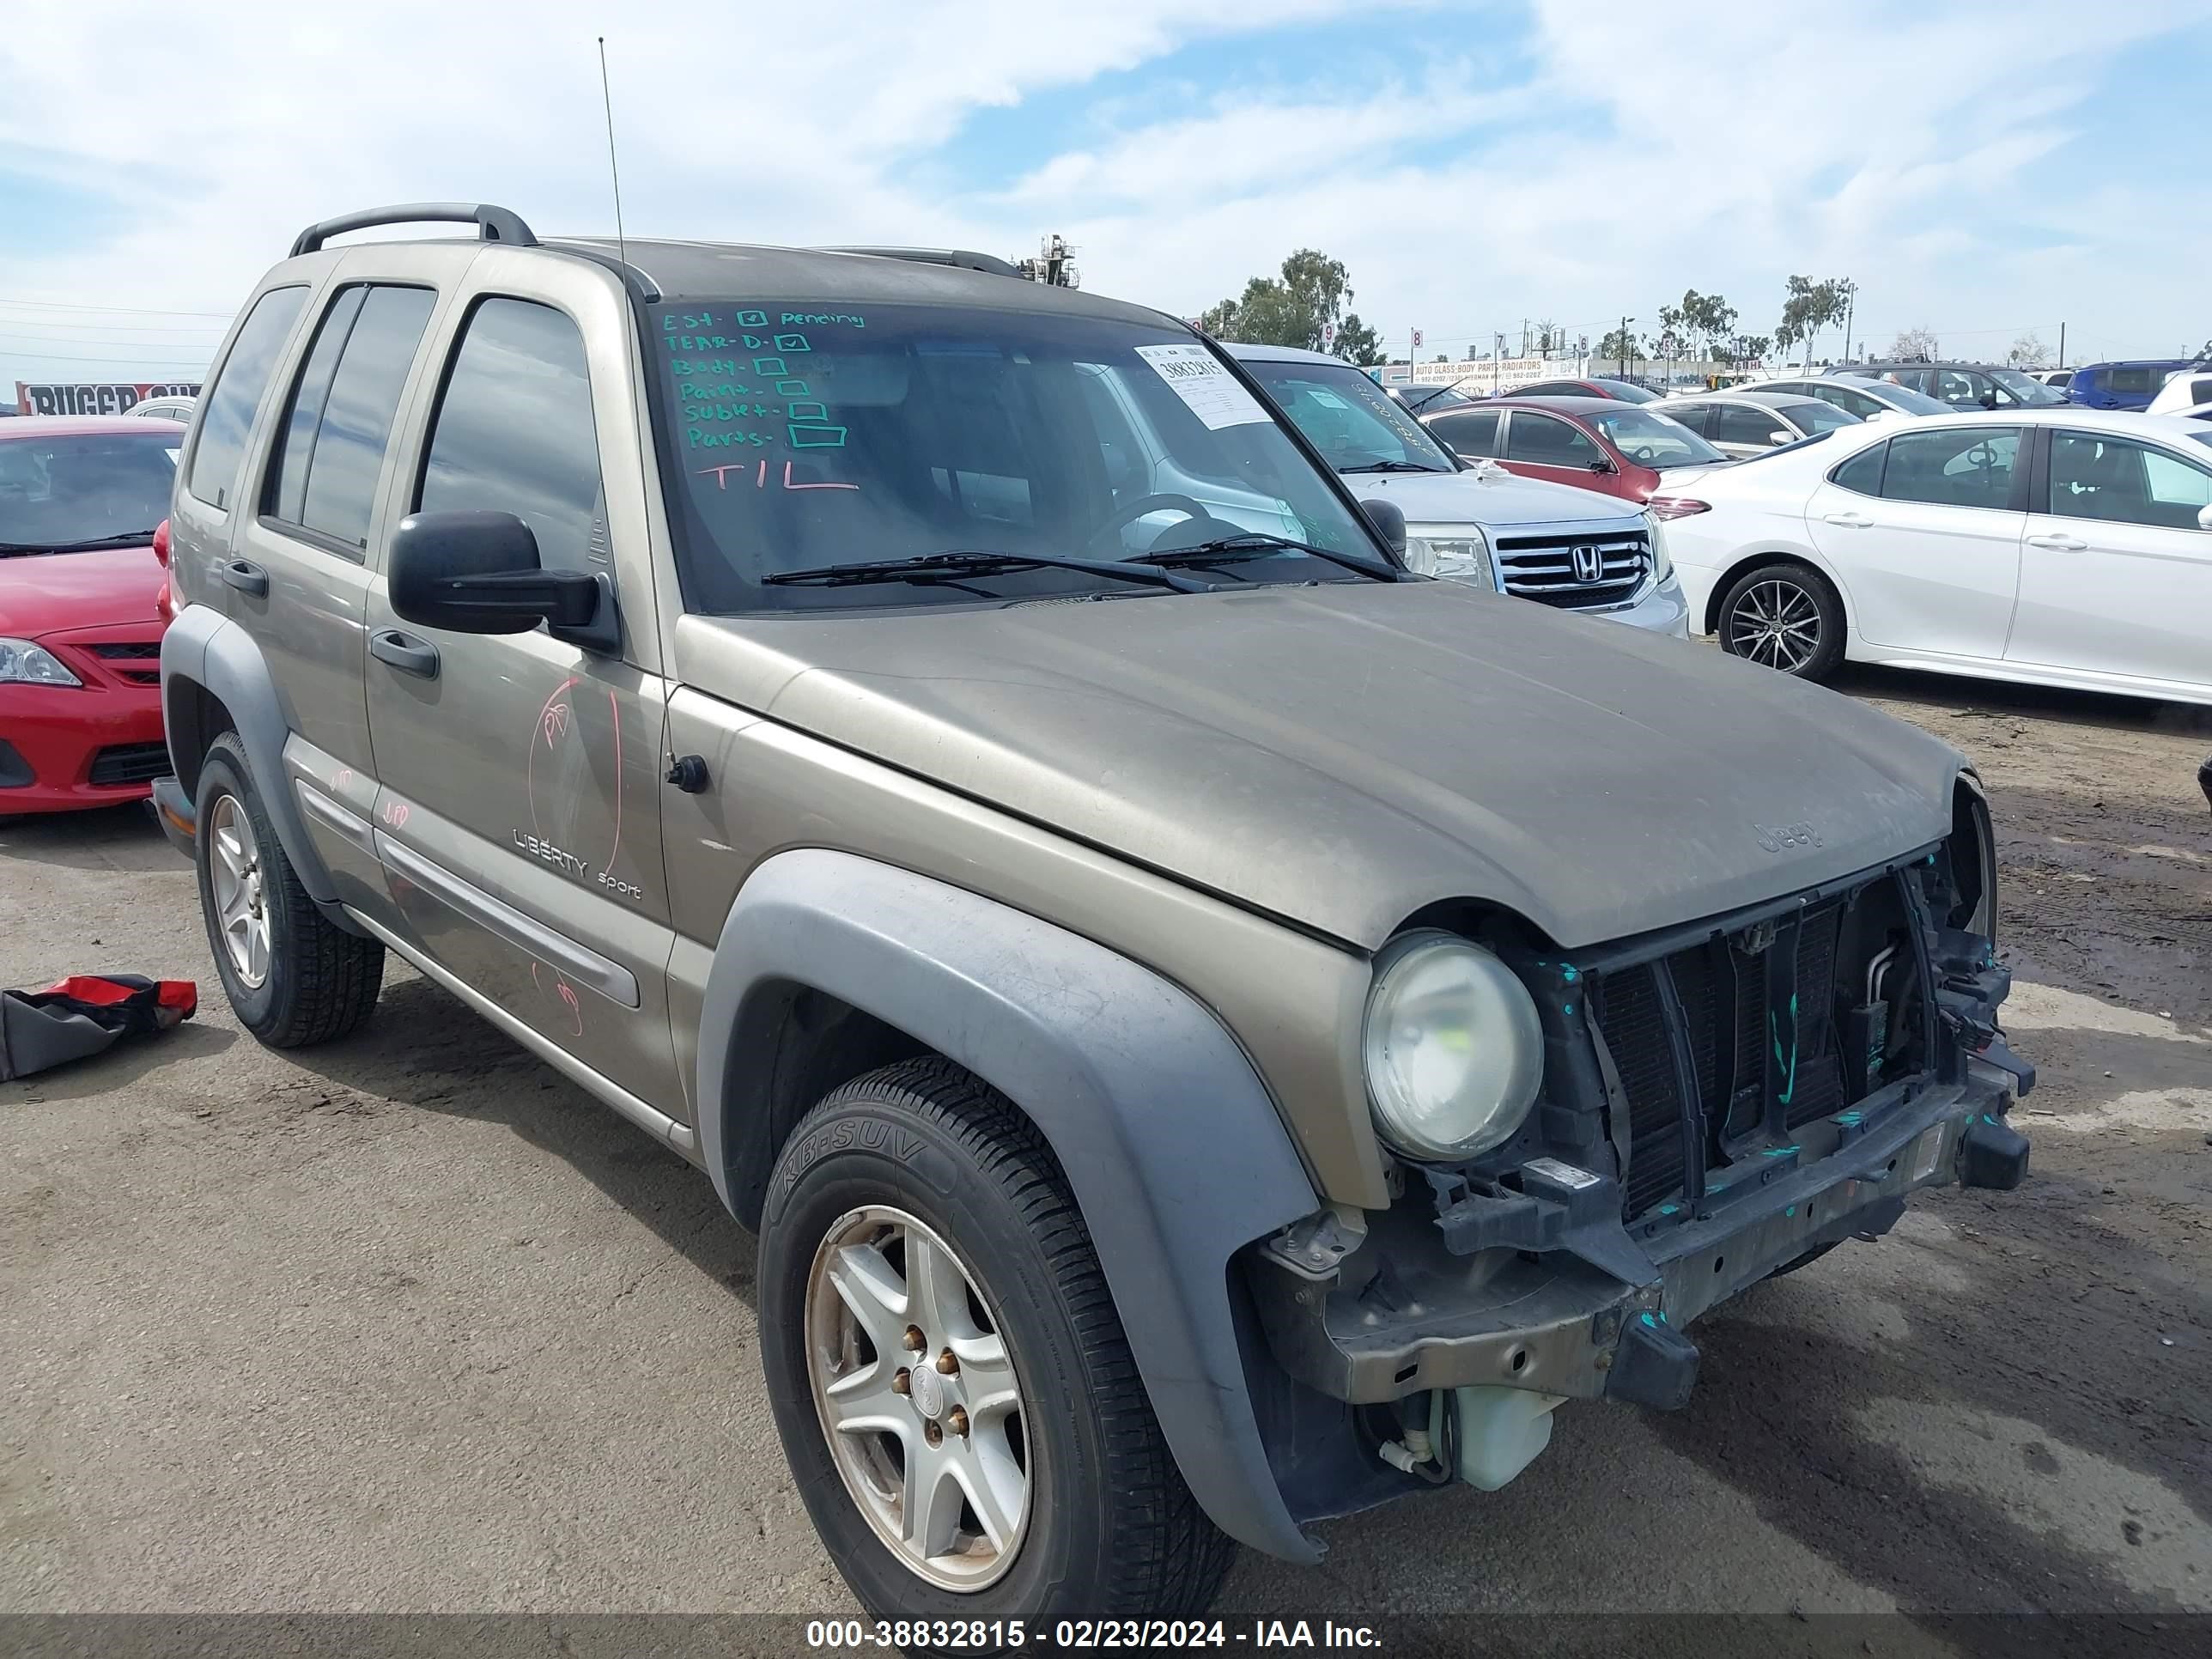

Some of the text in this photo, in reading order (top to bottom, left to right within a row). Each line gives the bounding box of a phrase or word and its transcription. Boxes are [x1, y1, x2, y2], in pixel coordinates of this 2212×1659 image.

[1325, 325, 1333, 340] 9
[1413, 332, 1421, 346] 8
[1498, 335, 1504, 350] 7
[1581, 337, 1587, 350] 6
[1665, 340, 1669, 353] 5
[1159, 361, 1223, 379] 38832815
[1415, 366, 1431, 375] AUTO
[1434, 364, 1455, 374] GLASS
[1457, 363, 1475, 373] BODY
[1501, 361, 1541, 371] RADIATORS
[1753, 821, 1823, 854] Jeep
[513, 828, 588, 878] LIBERTY
